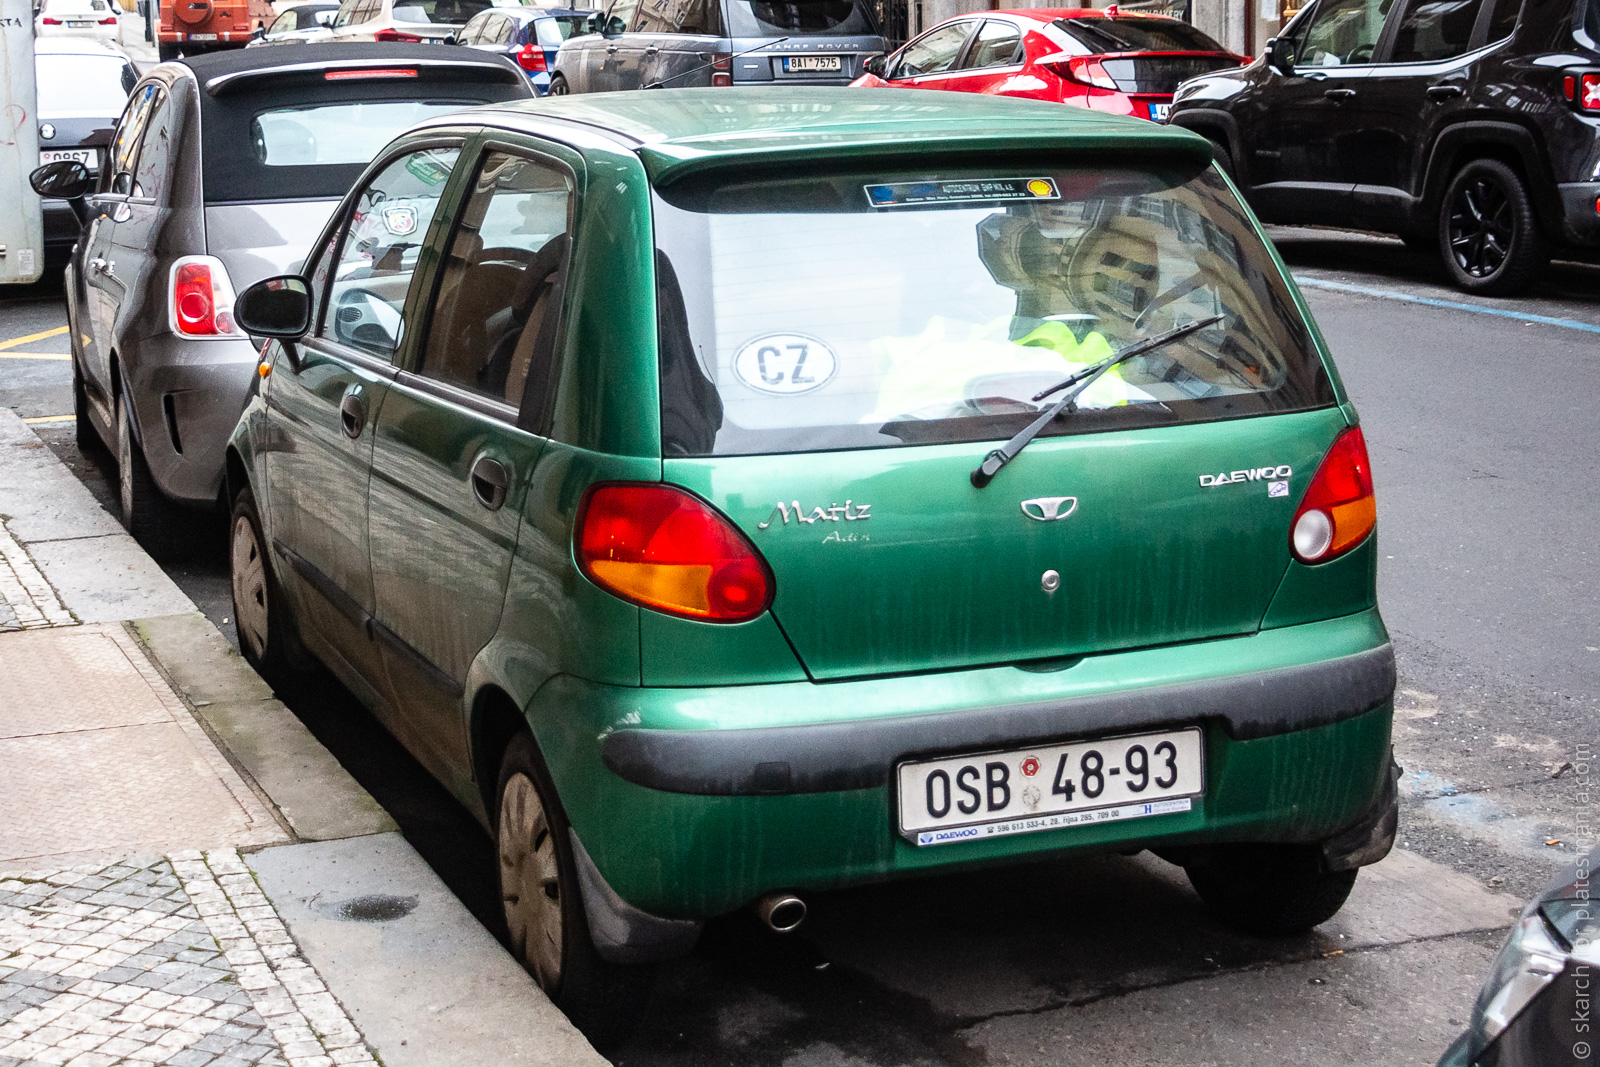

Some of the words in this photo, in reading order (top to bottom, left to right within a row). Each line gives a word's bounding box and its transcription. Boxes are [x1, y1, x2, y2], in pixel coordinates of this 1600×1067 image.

[814, 57, 837, 68] 7575
[757, 344, 816, 385] CZ
[1199, 464, 1293, 488] DAEWOO
[757, 499, 872, 528] Matiz
[926, 760, 1011, 819] OSB
[1051, 740, 1178, 802] 48-93
[935, 828, 978, 841] DAEWOO
[997, 824, 1010, 833] 596
[1011, 821, 1024, 831] 613
[1110, 809, 1120, 818] 00
